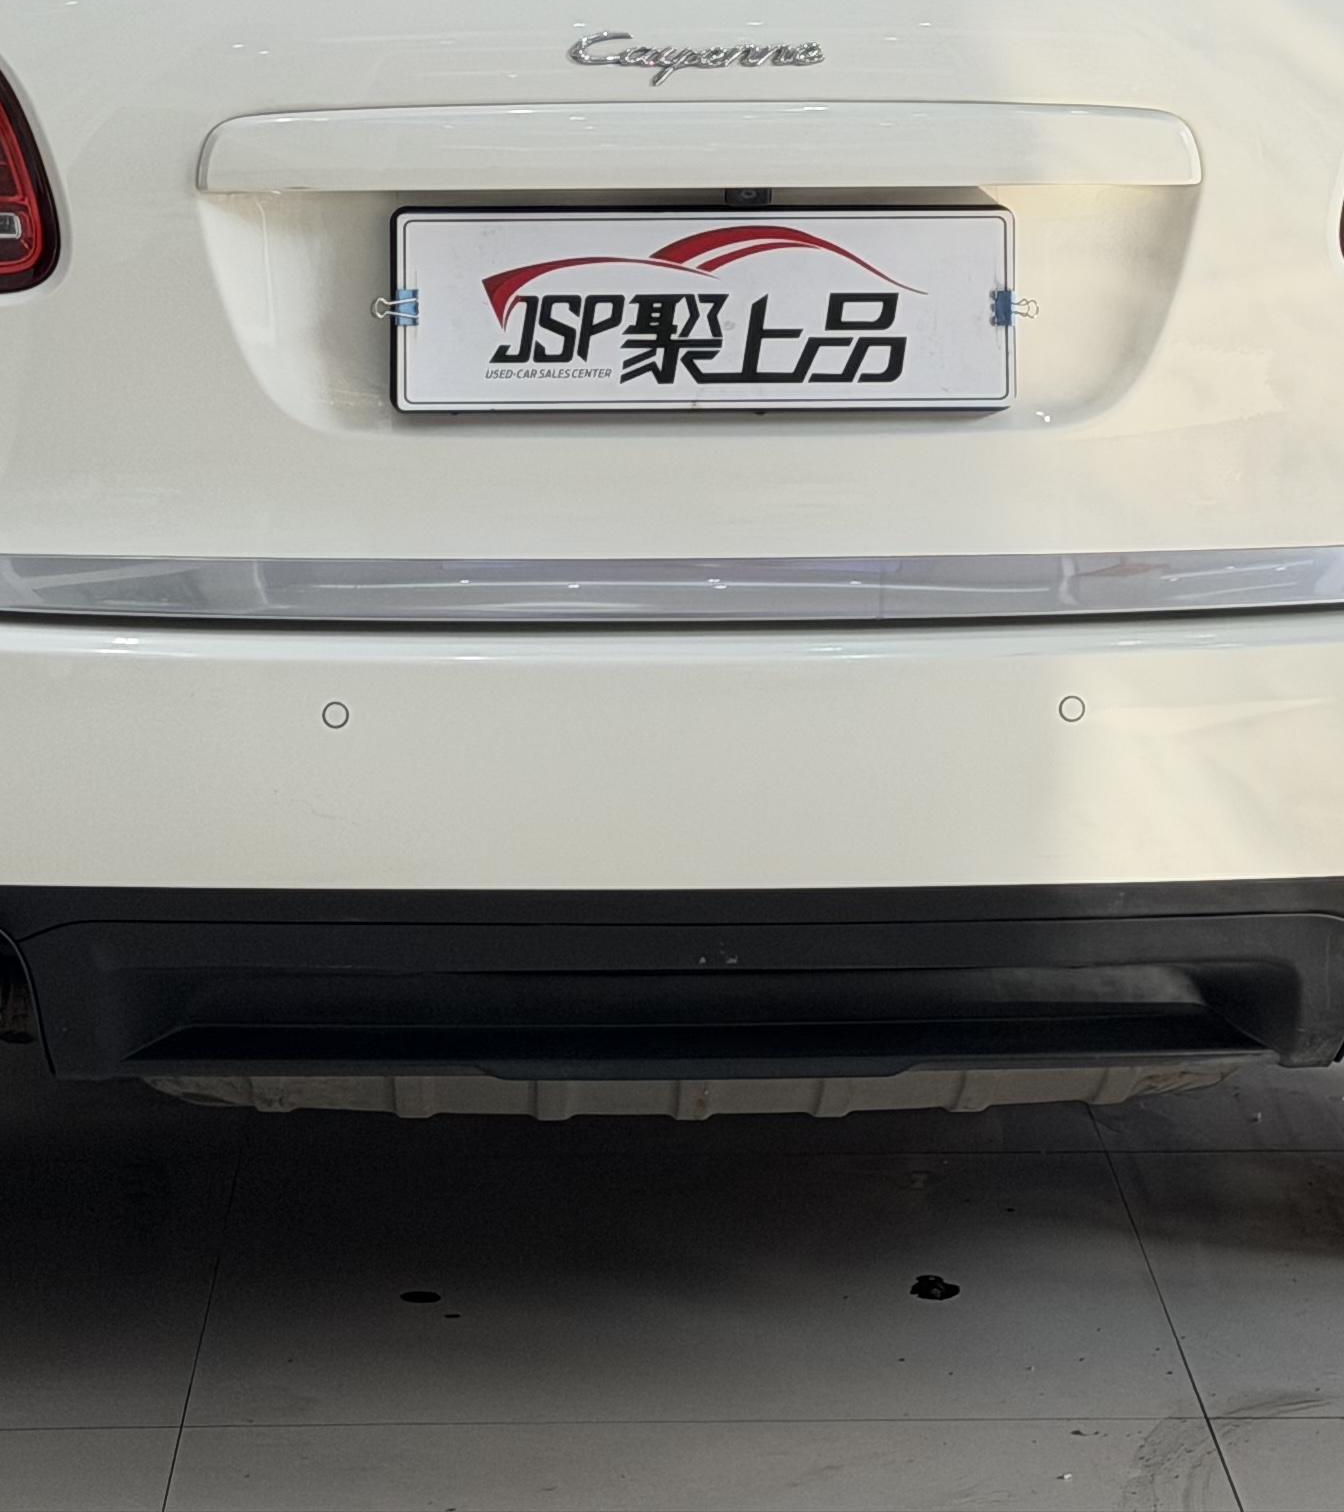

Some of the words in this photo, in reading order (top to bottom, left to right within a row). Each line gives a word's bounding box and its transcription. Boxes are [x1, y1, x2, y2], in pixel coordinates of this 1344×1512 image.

[567, 31, 825, 87] Cayenne
[489, 294, 625, 364] JSP
[619, 292, 908, 384] 聚上品
[536, 368, 571, 379] SALES
[571, 368, 612, 379] CENTER
